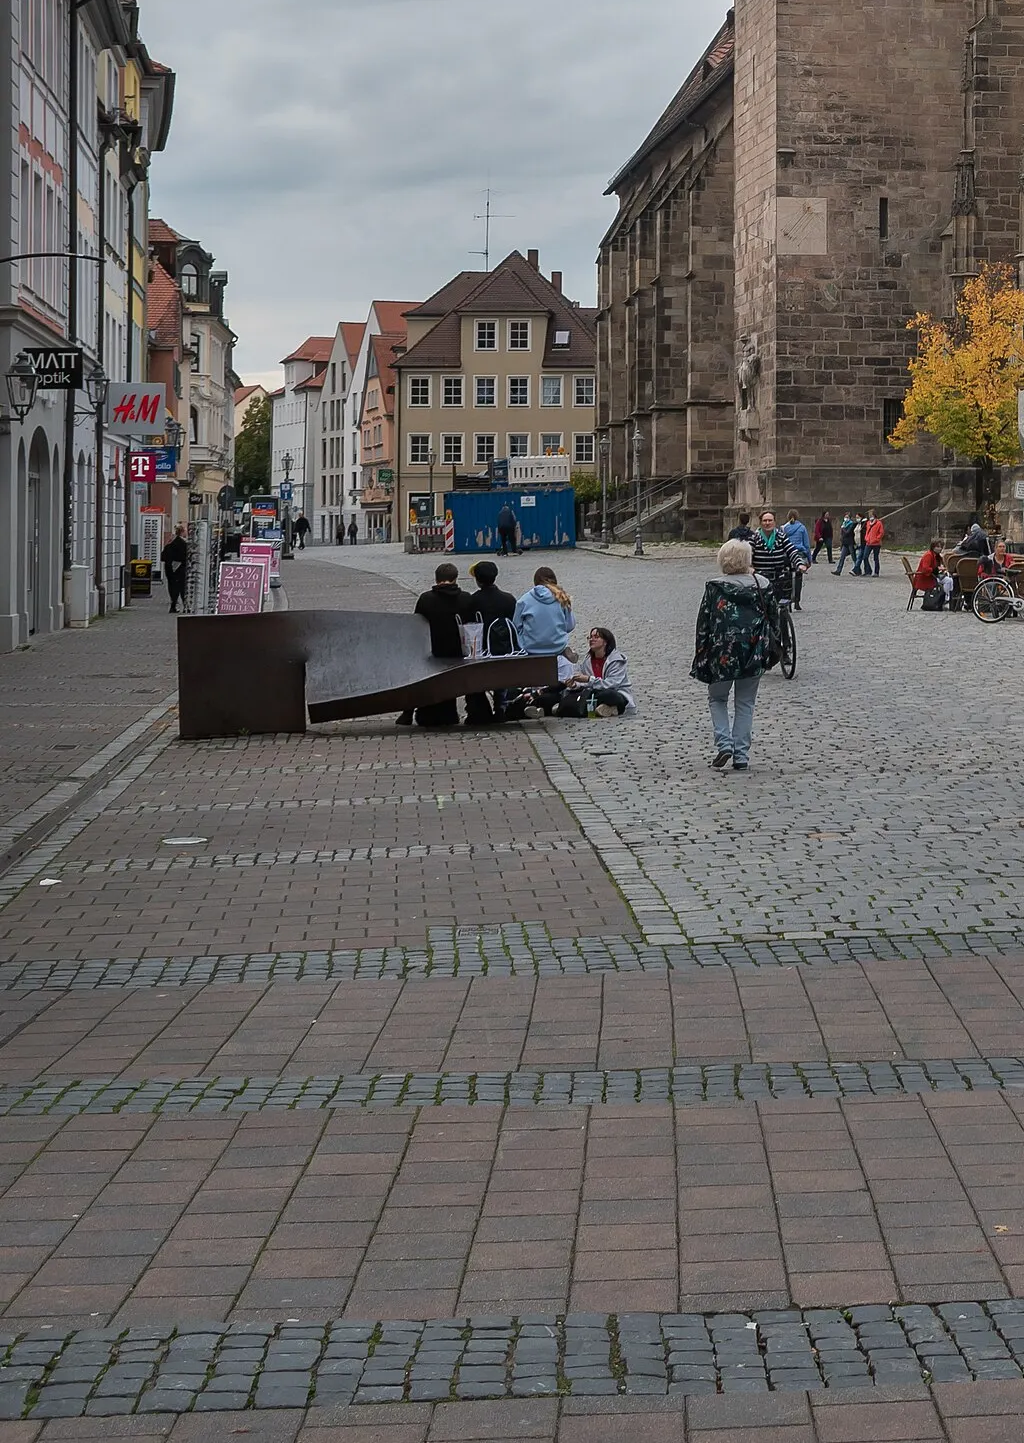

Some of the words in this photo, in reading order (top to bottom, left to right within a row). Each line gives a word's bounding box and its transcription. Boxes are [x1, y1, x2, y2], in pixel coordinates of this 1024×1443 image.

[28, 352, 79, 369] MATT
[113, 394, 161, 424] H&M
[131, 456, 150, 477] T
[224, 566, 259, 580] 25%
[223, 580, 257, 589] RABATT
[221, 597, 256, 605] SONNEN
